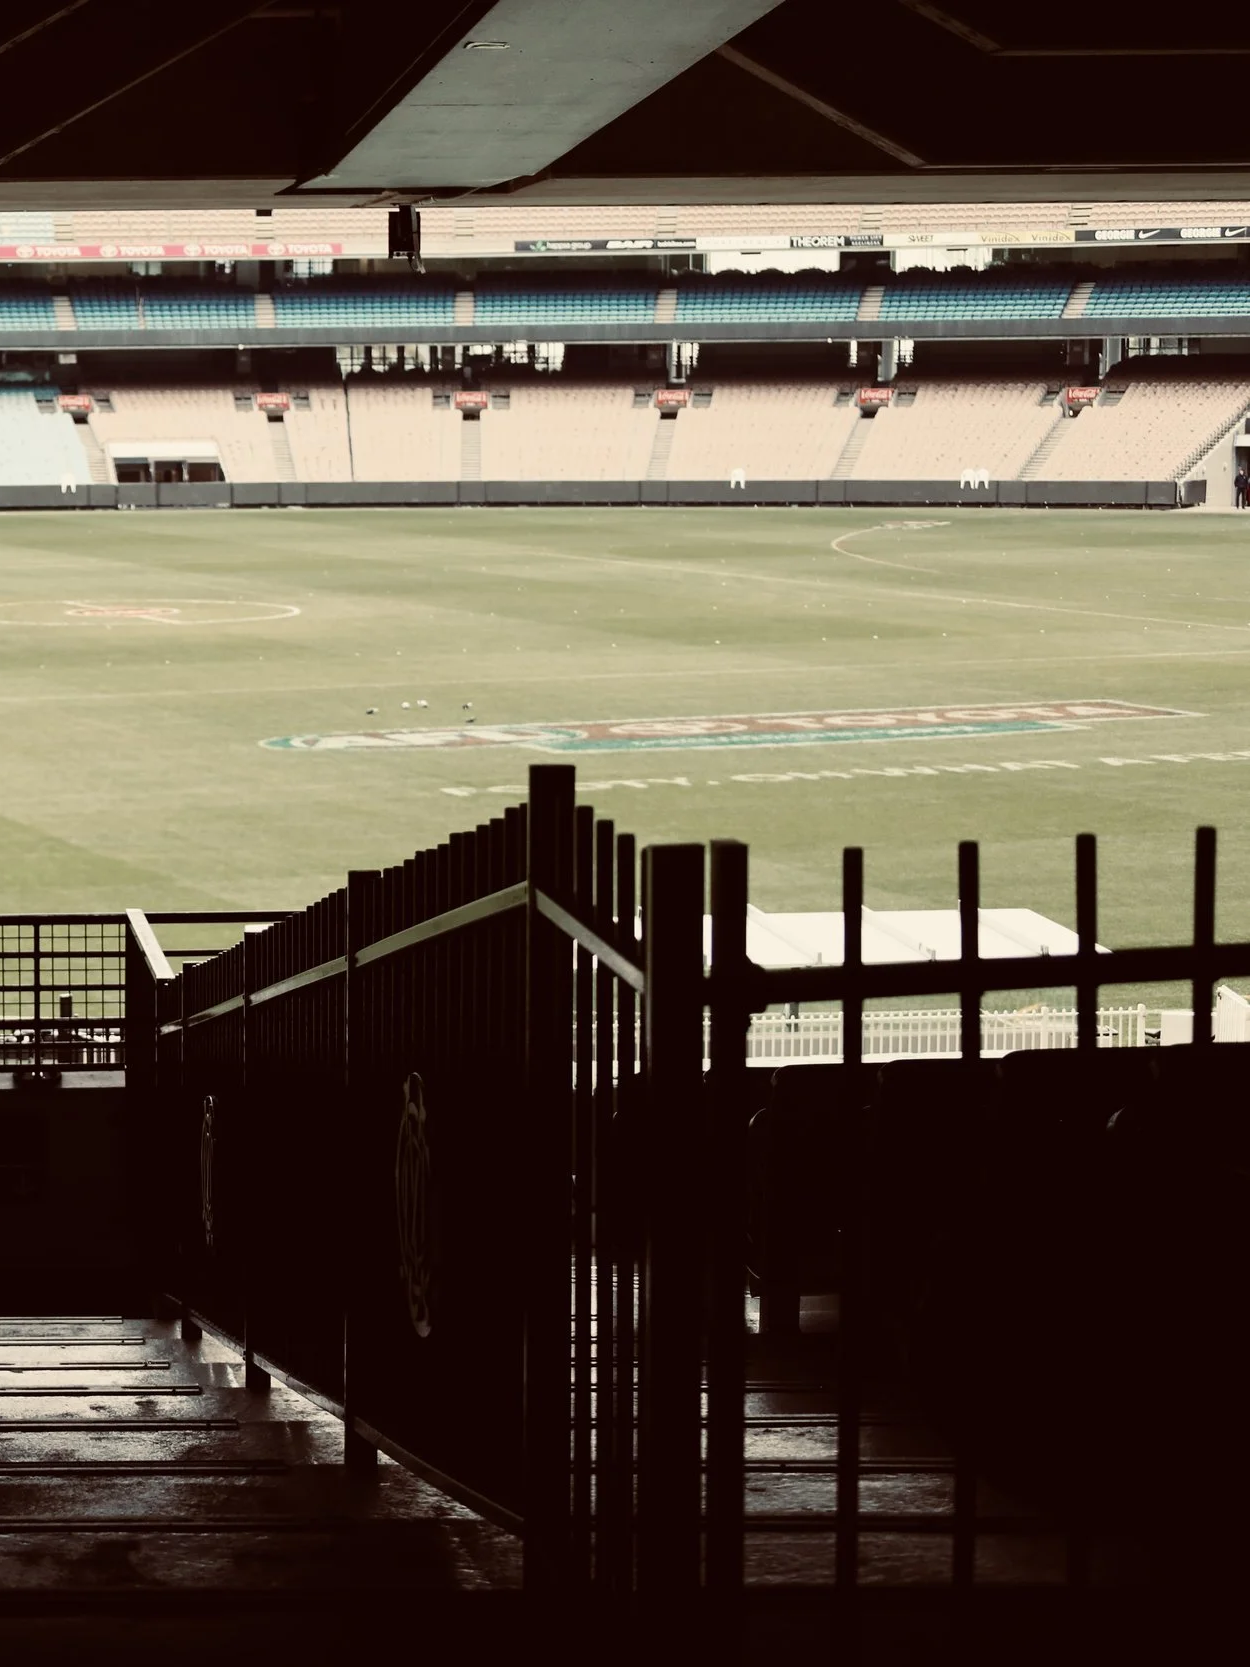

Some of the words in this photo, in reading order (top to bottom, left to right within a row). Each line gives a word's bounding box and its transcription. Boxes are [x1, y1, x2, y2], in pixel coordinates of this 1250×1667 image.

[791, 236, 844, 247] THEOREM
[980, 234, 1021, 243] Vinidex
[1031, 233, 1071, 242] Vinidex
[37, 247, 81, 257] TOYOTA
[120, 247, 165, 256] TOYOTA
[203, 246, 248, 255] TOYOTA
[286, 245, 333, 254] TOYOTA
